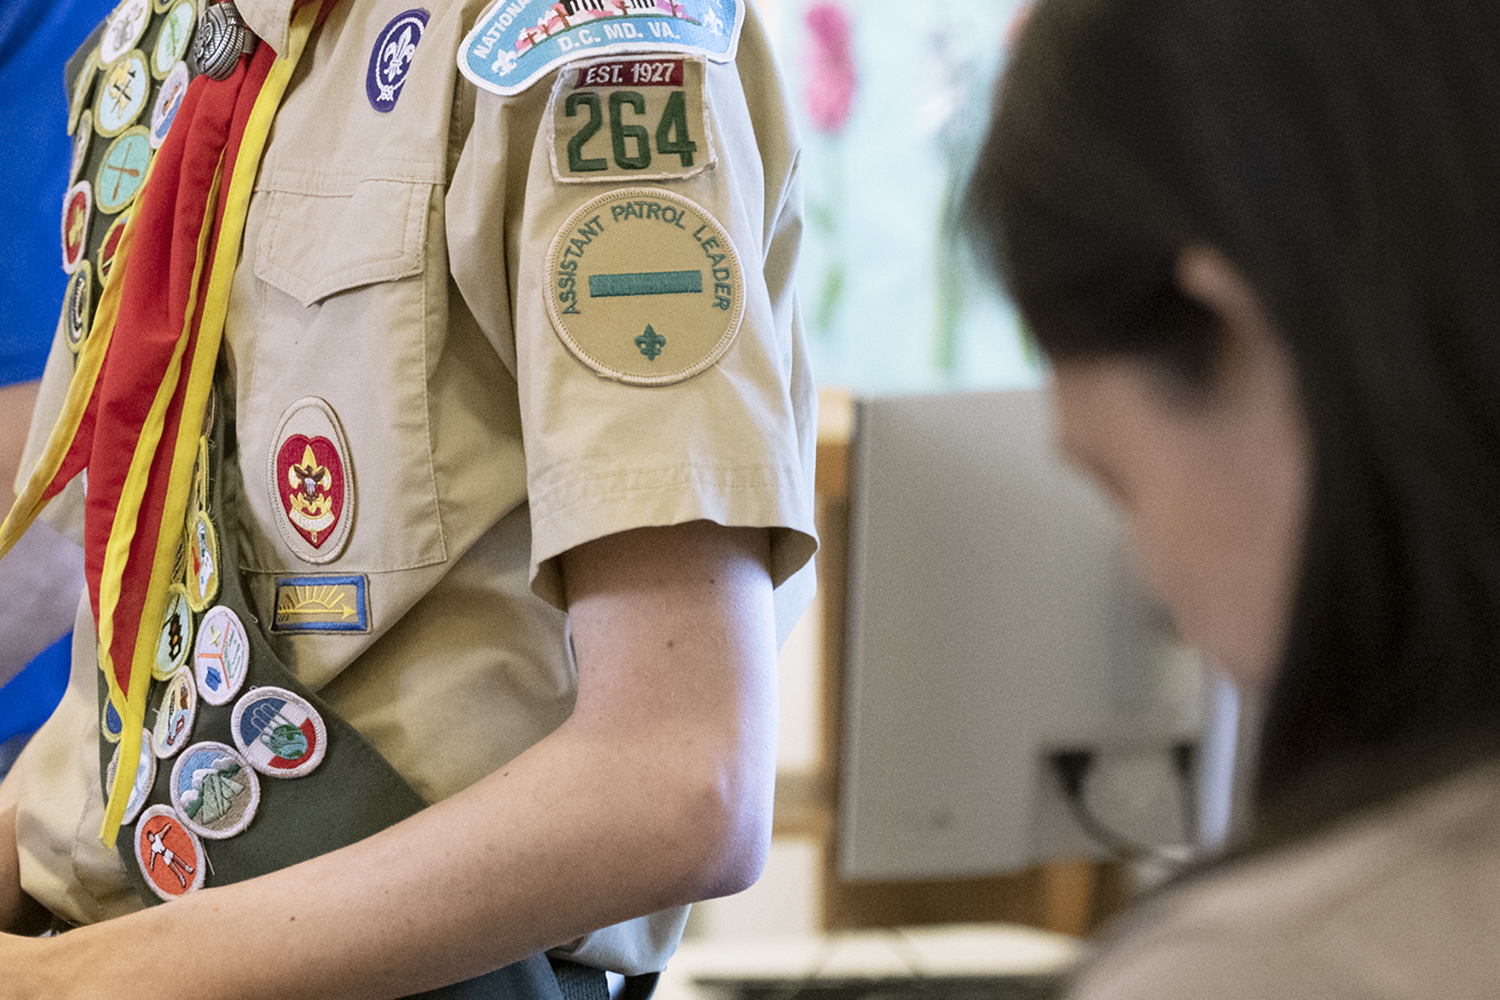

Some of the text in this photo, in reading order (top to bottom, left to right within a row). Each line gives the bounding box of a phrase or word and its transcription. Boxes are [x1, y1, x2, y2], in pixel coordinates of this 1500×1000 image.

[557, 21, 681, 52] D.C. MD. VA.
[585, 62, 676, 85] EST. 1927
[565, 90, 698, 173] 264
[558, 200, 732, 315] ASSISTANT PATROL LEADER
